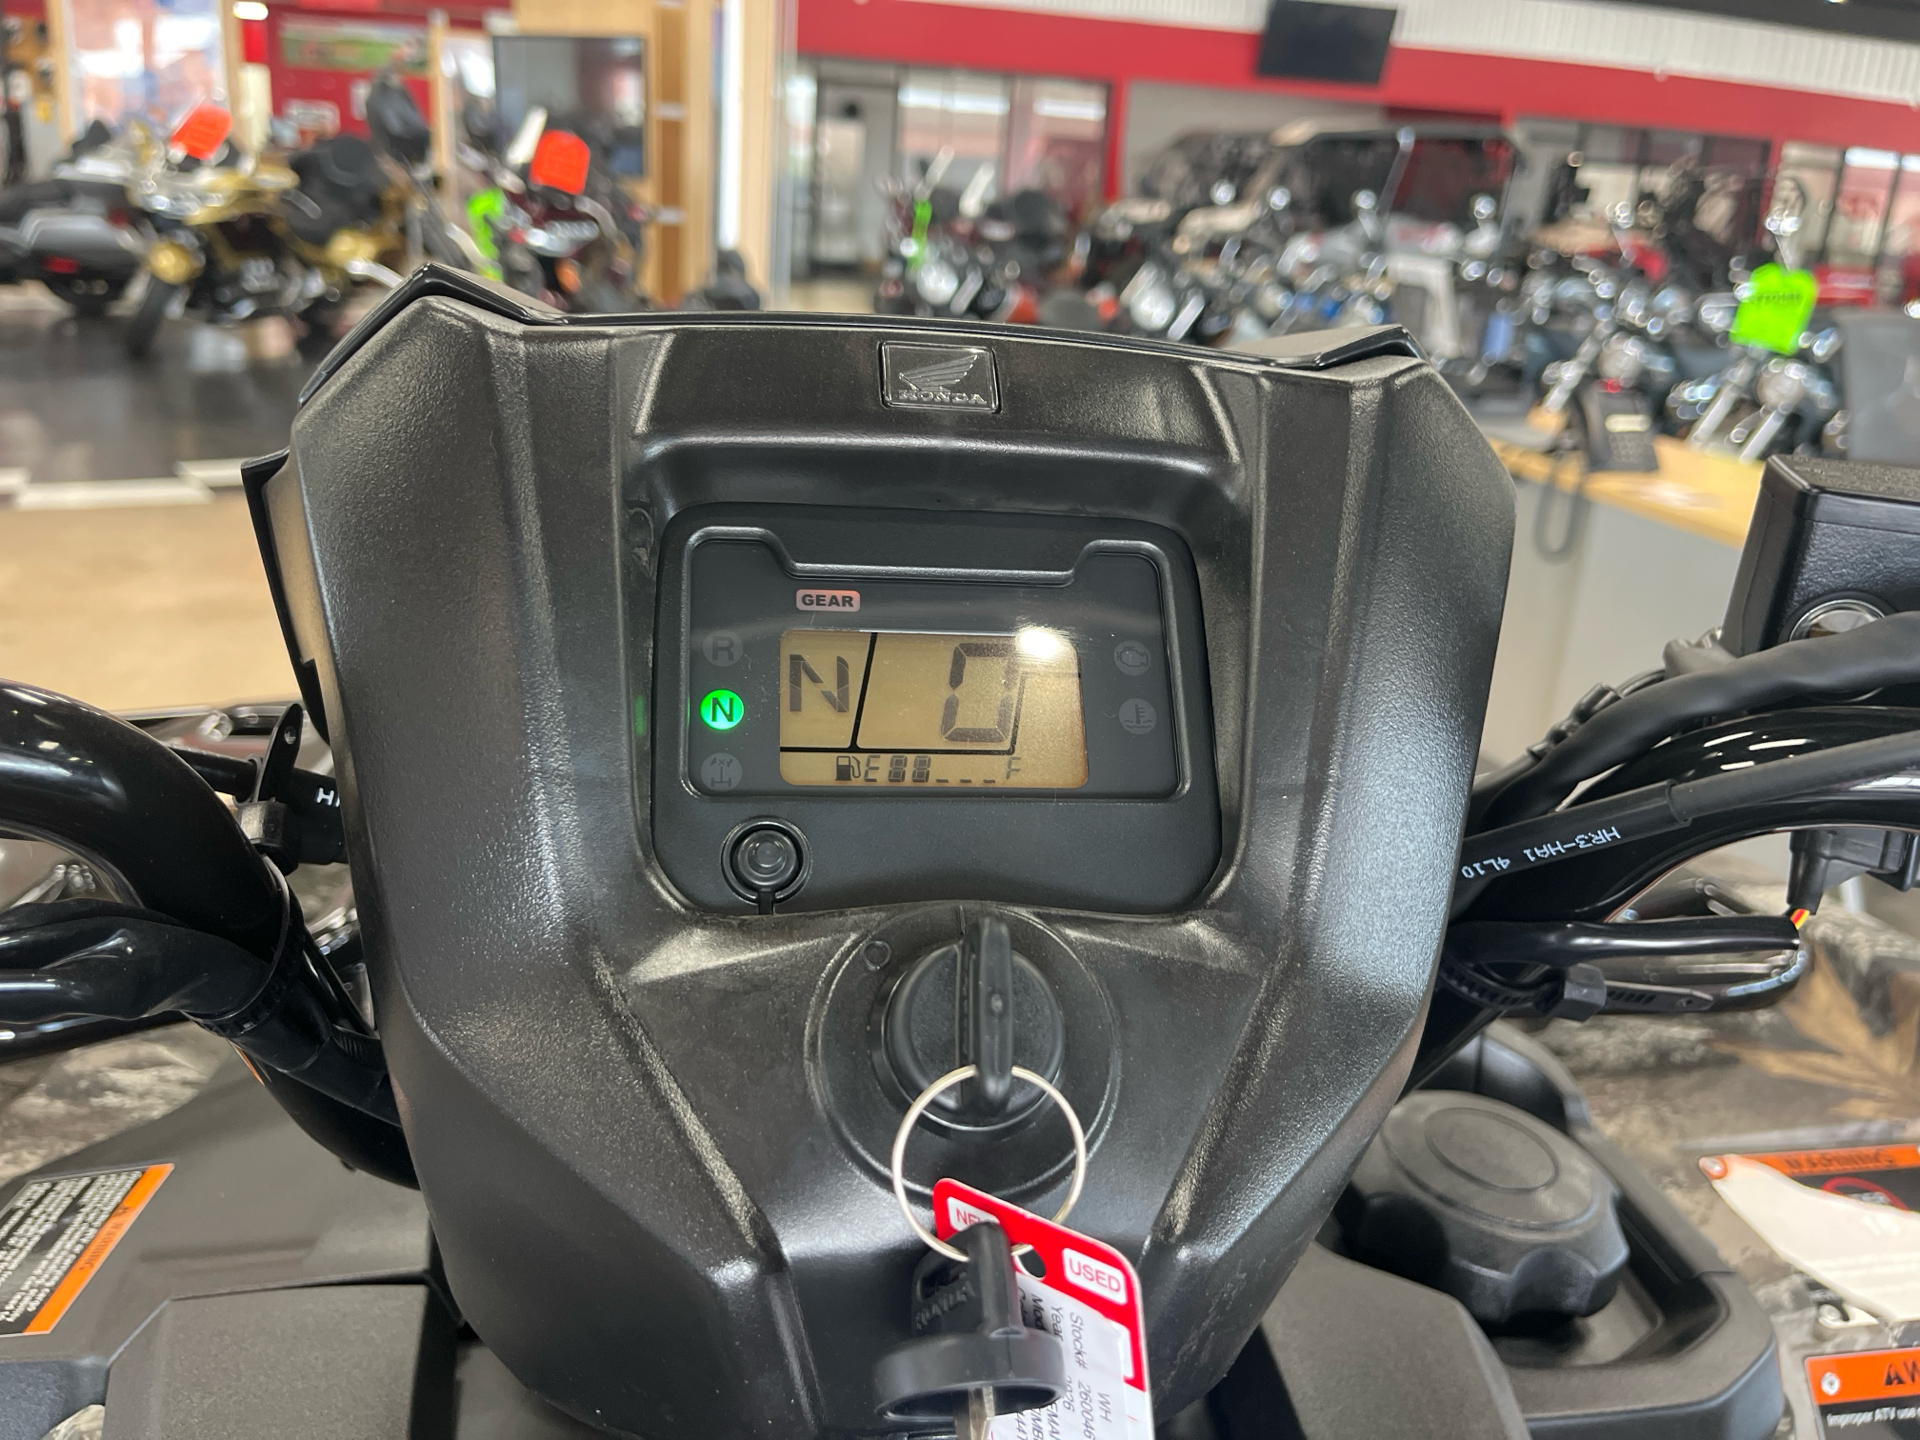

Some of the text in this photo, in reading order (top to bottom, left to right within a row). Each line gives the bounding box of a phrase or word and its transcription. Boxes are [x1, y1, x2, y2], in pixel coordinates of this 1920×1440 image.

[898, 389, 988, 404] HONDA
[801, 594, 854, 608] GEAR
[711, 636, 735, 661] R
[789, 654, 850, 713] N
[711, 697, 734, 723] N
[1461, 826, 1622, 879] HR3-HA1 4L10
[956, 1208, 986, 1226] NE
[1069, 1258, 1121, 1293] USED
[1051, 1305, 1063, 1341] Year
[1070, 1312, 1088, 1370] Stock#
[1097, 1392, 1112, 1423] WH
